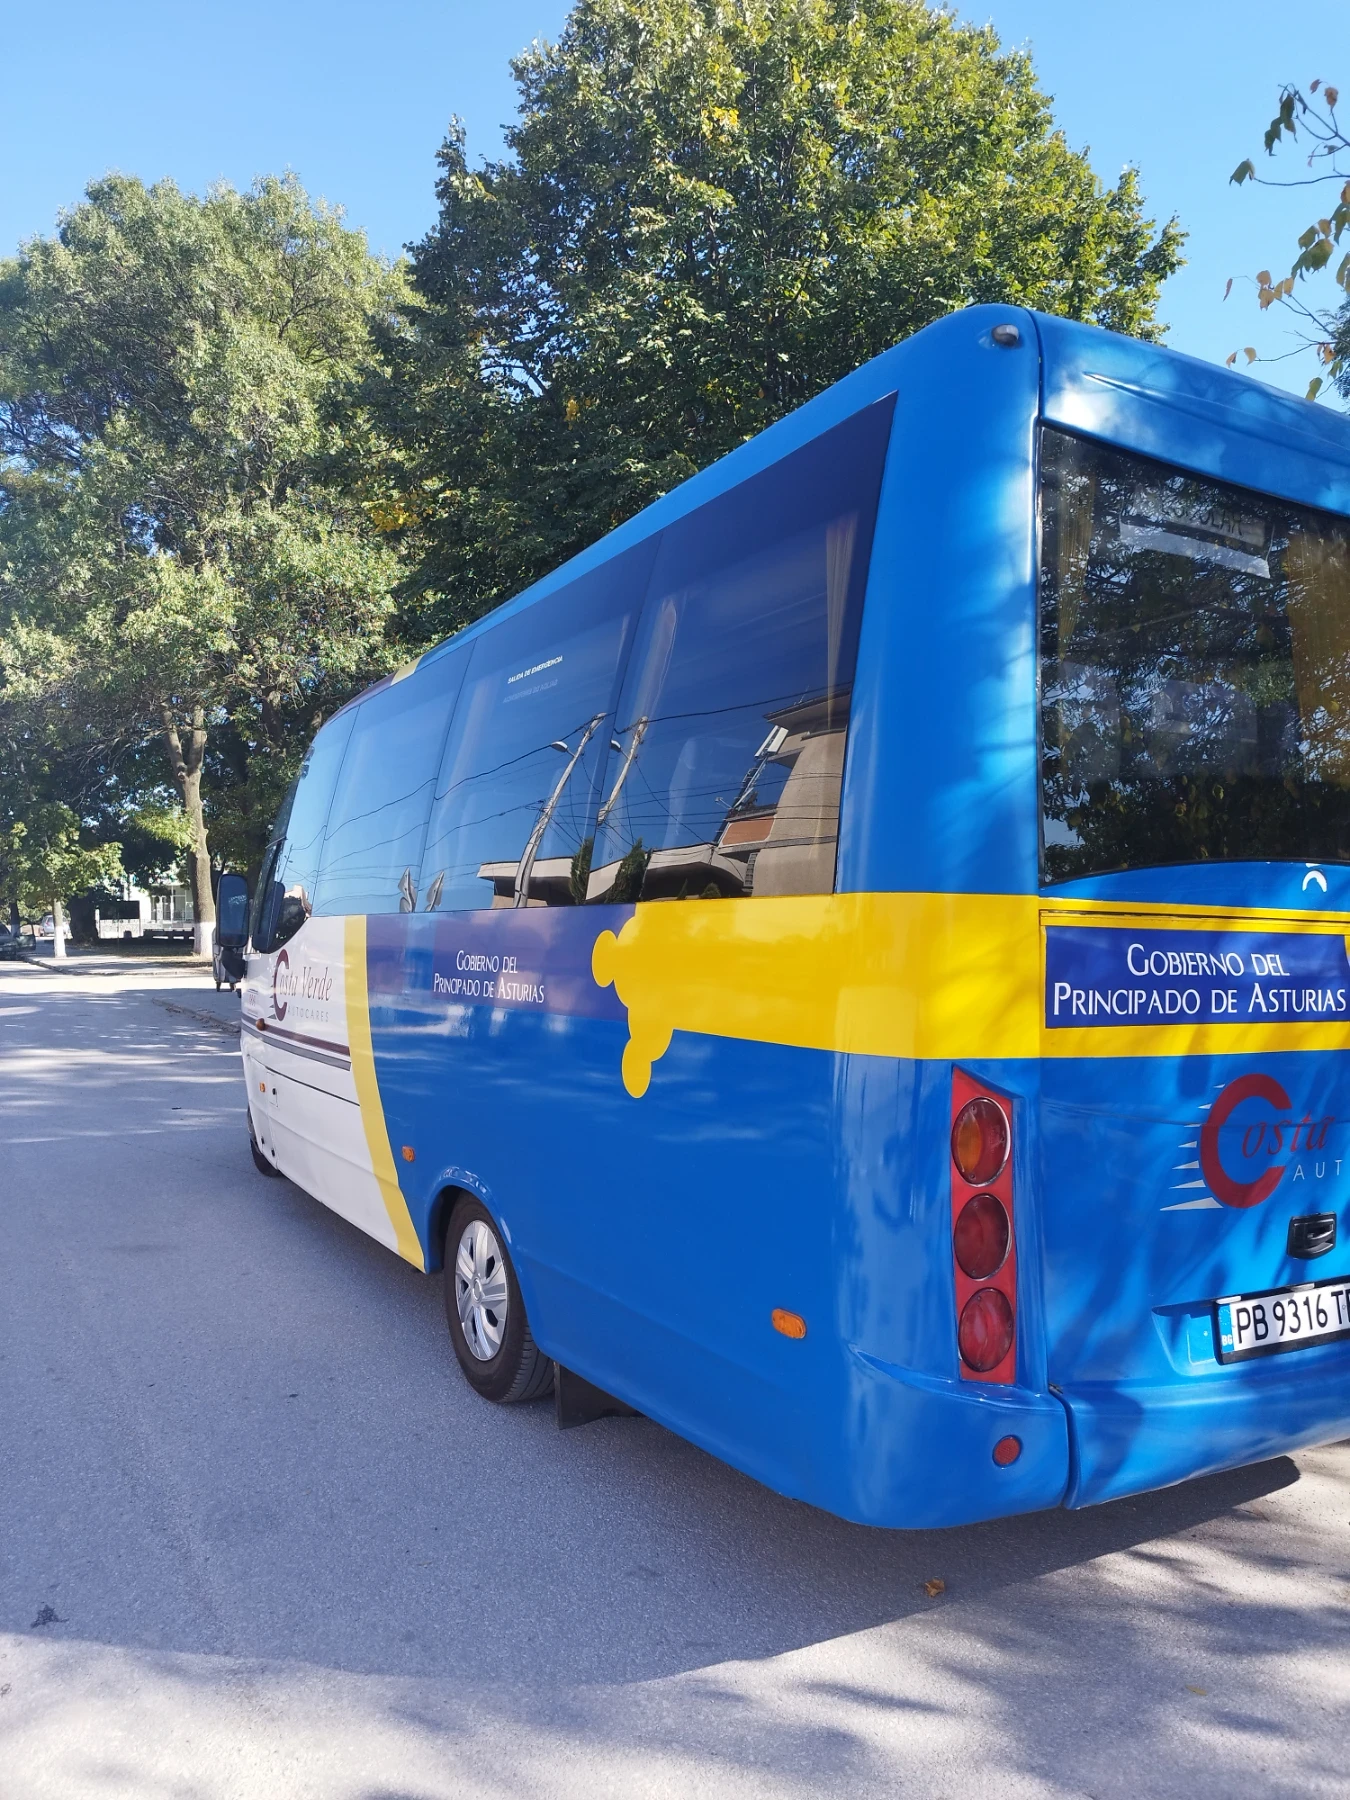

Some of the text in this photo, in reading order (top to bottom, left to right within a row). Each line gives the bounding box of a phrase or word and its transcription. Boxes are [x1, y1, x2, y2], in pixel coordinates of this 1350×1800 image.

[456, 949, 518, 974] GOBIERNO DEL
[1127, 943, 1290, 977] GOBIERNO DEL
[273, 949, 333, 1022] Costa Verde
[434, 973, 545, 1003] PRINCIPADO DE ASTURIAS
[1054, 982, 1346, 1015] PRINCIPADO DE ASTURIAS
[287, 1005, 330, 1023] AUTOCARES
[1200, 1072, 1335, 1209] Costa
[1221, 1333, 1233, 1346] BG
[1236, 1304, 1269, 1344] PB
[1272, 1294, 1328, 1337] 9316
